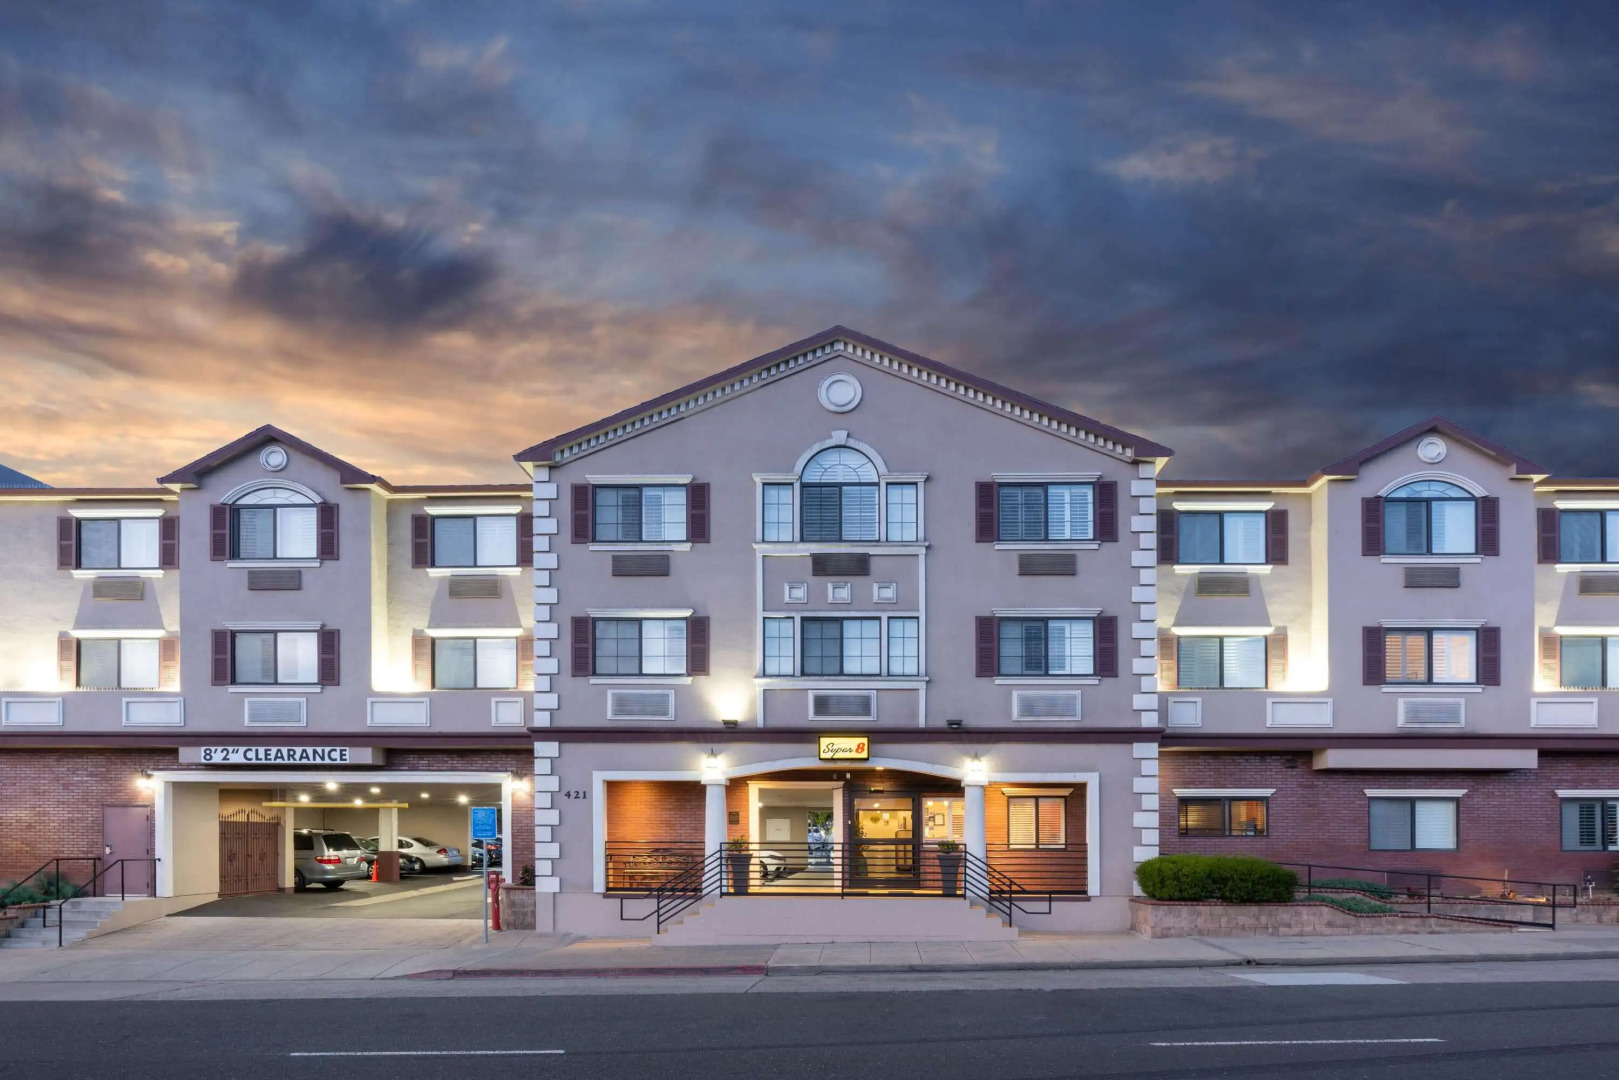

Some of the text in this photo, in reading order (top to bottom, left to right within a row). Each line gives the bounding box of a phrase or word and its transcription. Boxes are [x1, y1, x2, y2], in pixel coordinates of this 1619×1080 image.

[243, 748, 348, 761] CLEARANCE
[822, 742, 866, 759] Super 8
[564, 790, 587, 800] 421
